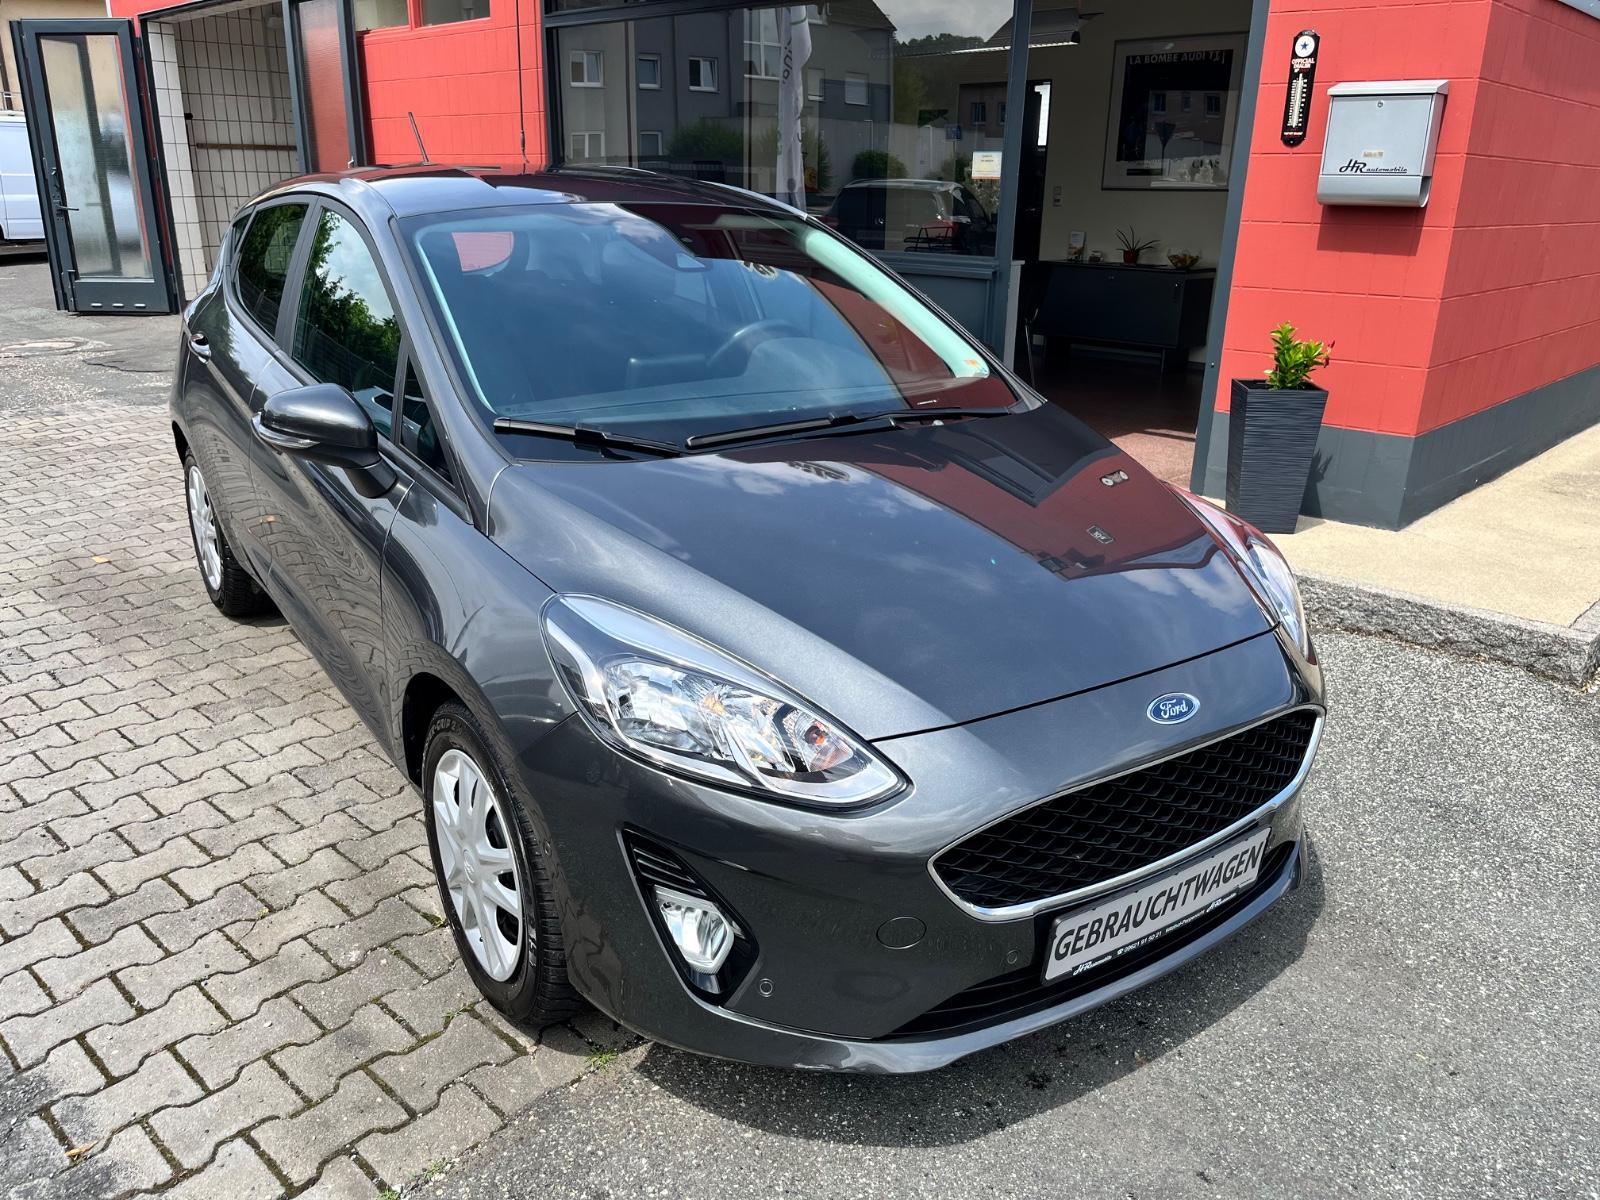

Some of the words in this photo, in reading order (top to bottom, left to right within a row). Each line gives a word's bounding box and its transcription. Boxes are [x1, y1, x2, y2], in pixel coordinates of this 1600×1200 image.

[1129, 55, 1141, 65] LA
[1144, 53, 1180, 64] BOMBE
[1181, 51, 1206, 62] AUDI
[1159, 698, 1189, 719] Ford
[1054, 843, 1263, 961] GEBRAUCHTWAGEN
